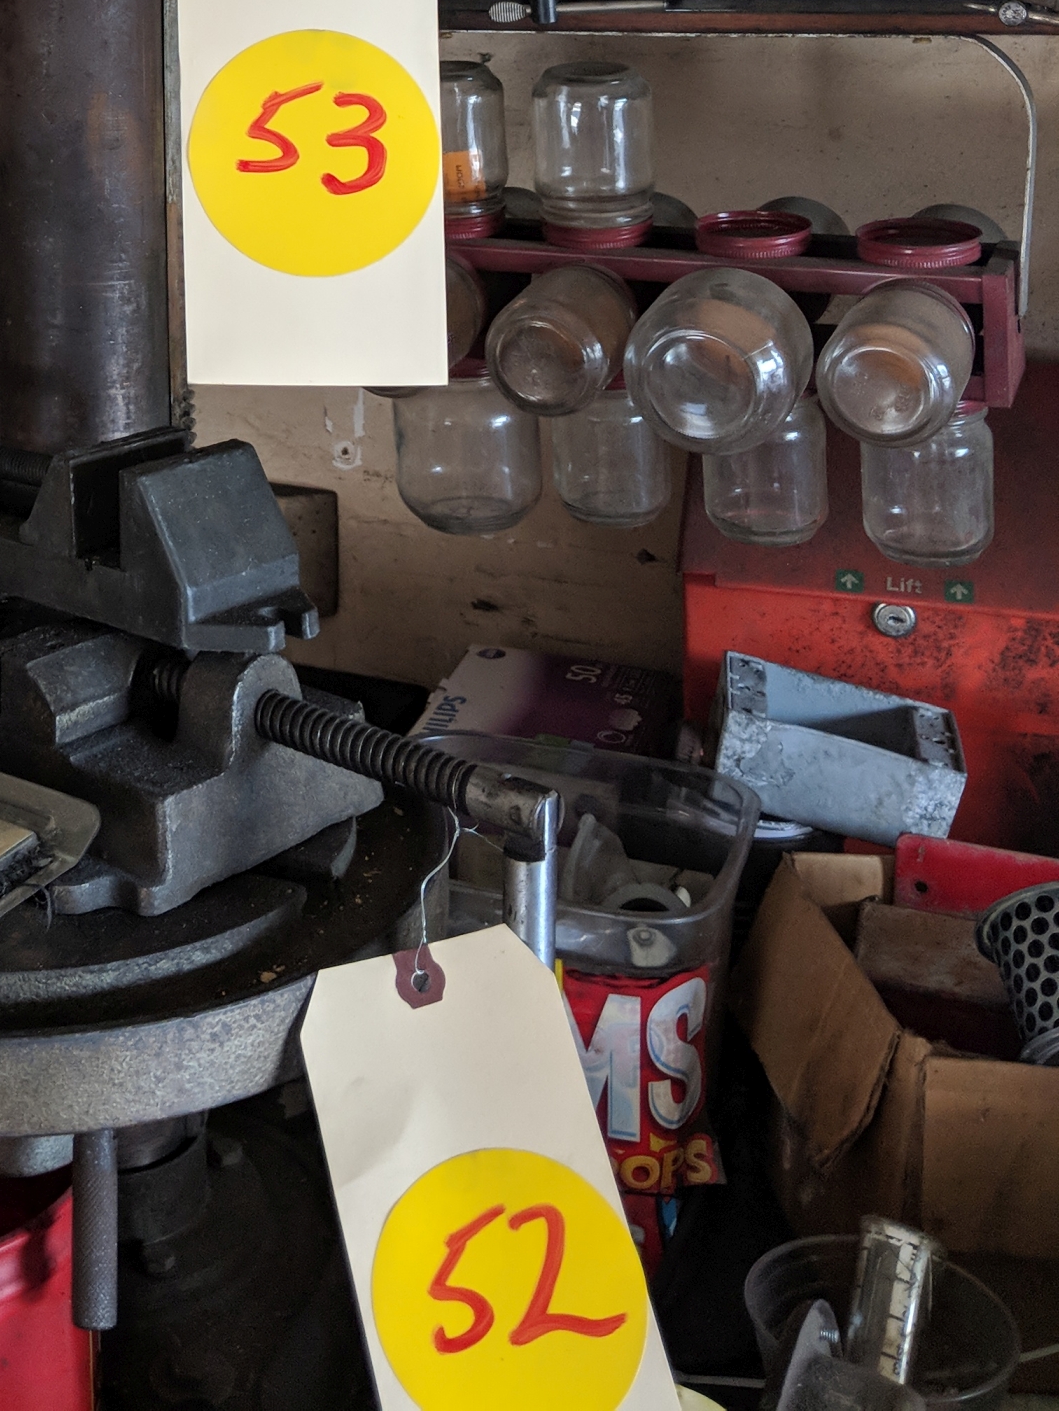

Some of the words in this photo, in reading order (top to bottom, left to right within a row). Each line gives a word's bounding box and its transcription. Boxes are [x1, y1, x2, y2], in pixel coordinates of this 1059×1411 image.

[235, 80, 388, 196] 53
[886, 576, 922, 594] Lift
[566, 664, 602, 684] 50
[562, 977, 707, 1142] MS
[612, 1138, 712, 1193] OPS
[426, 1203, 628, 1355] 52
